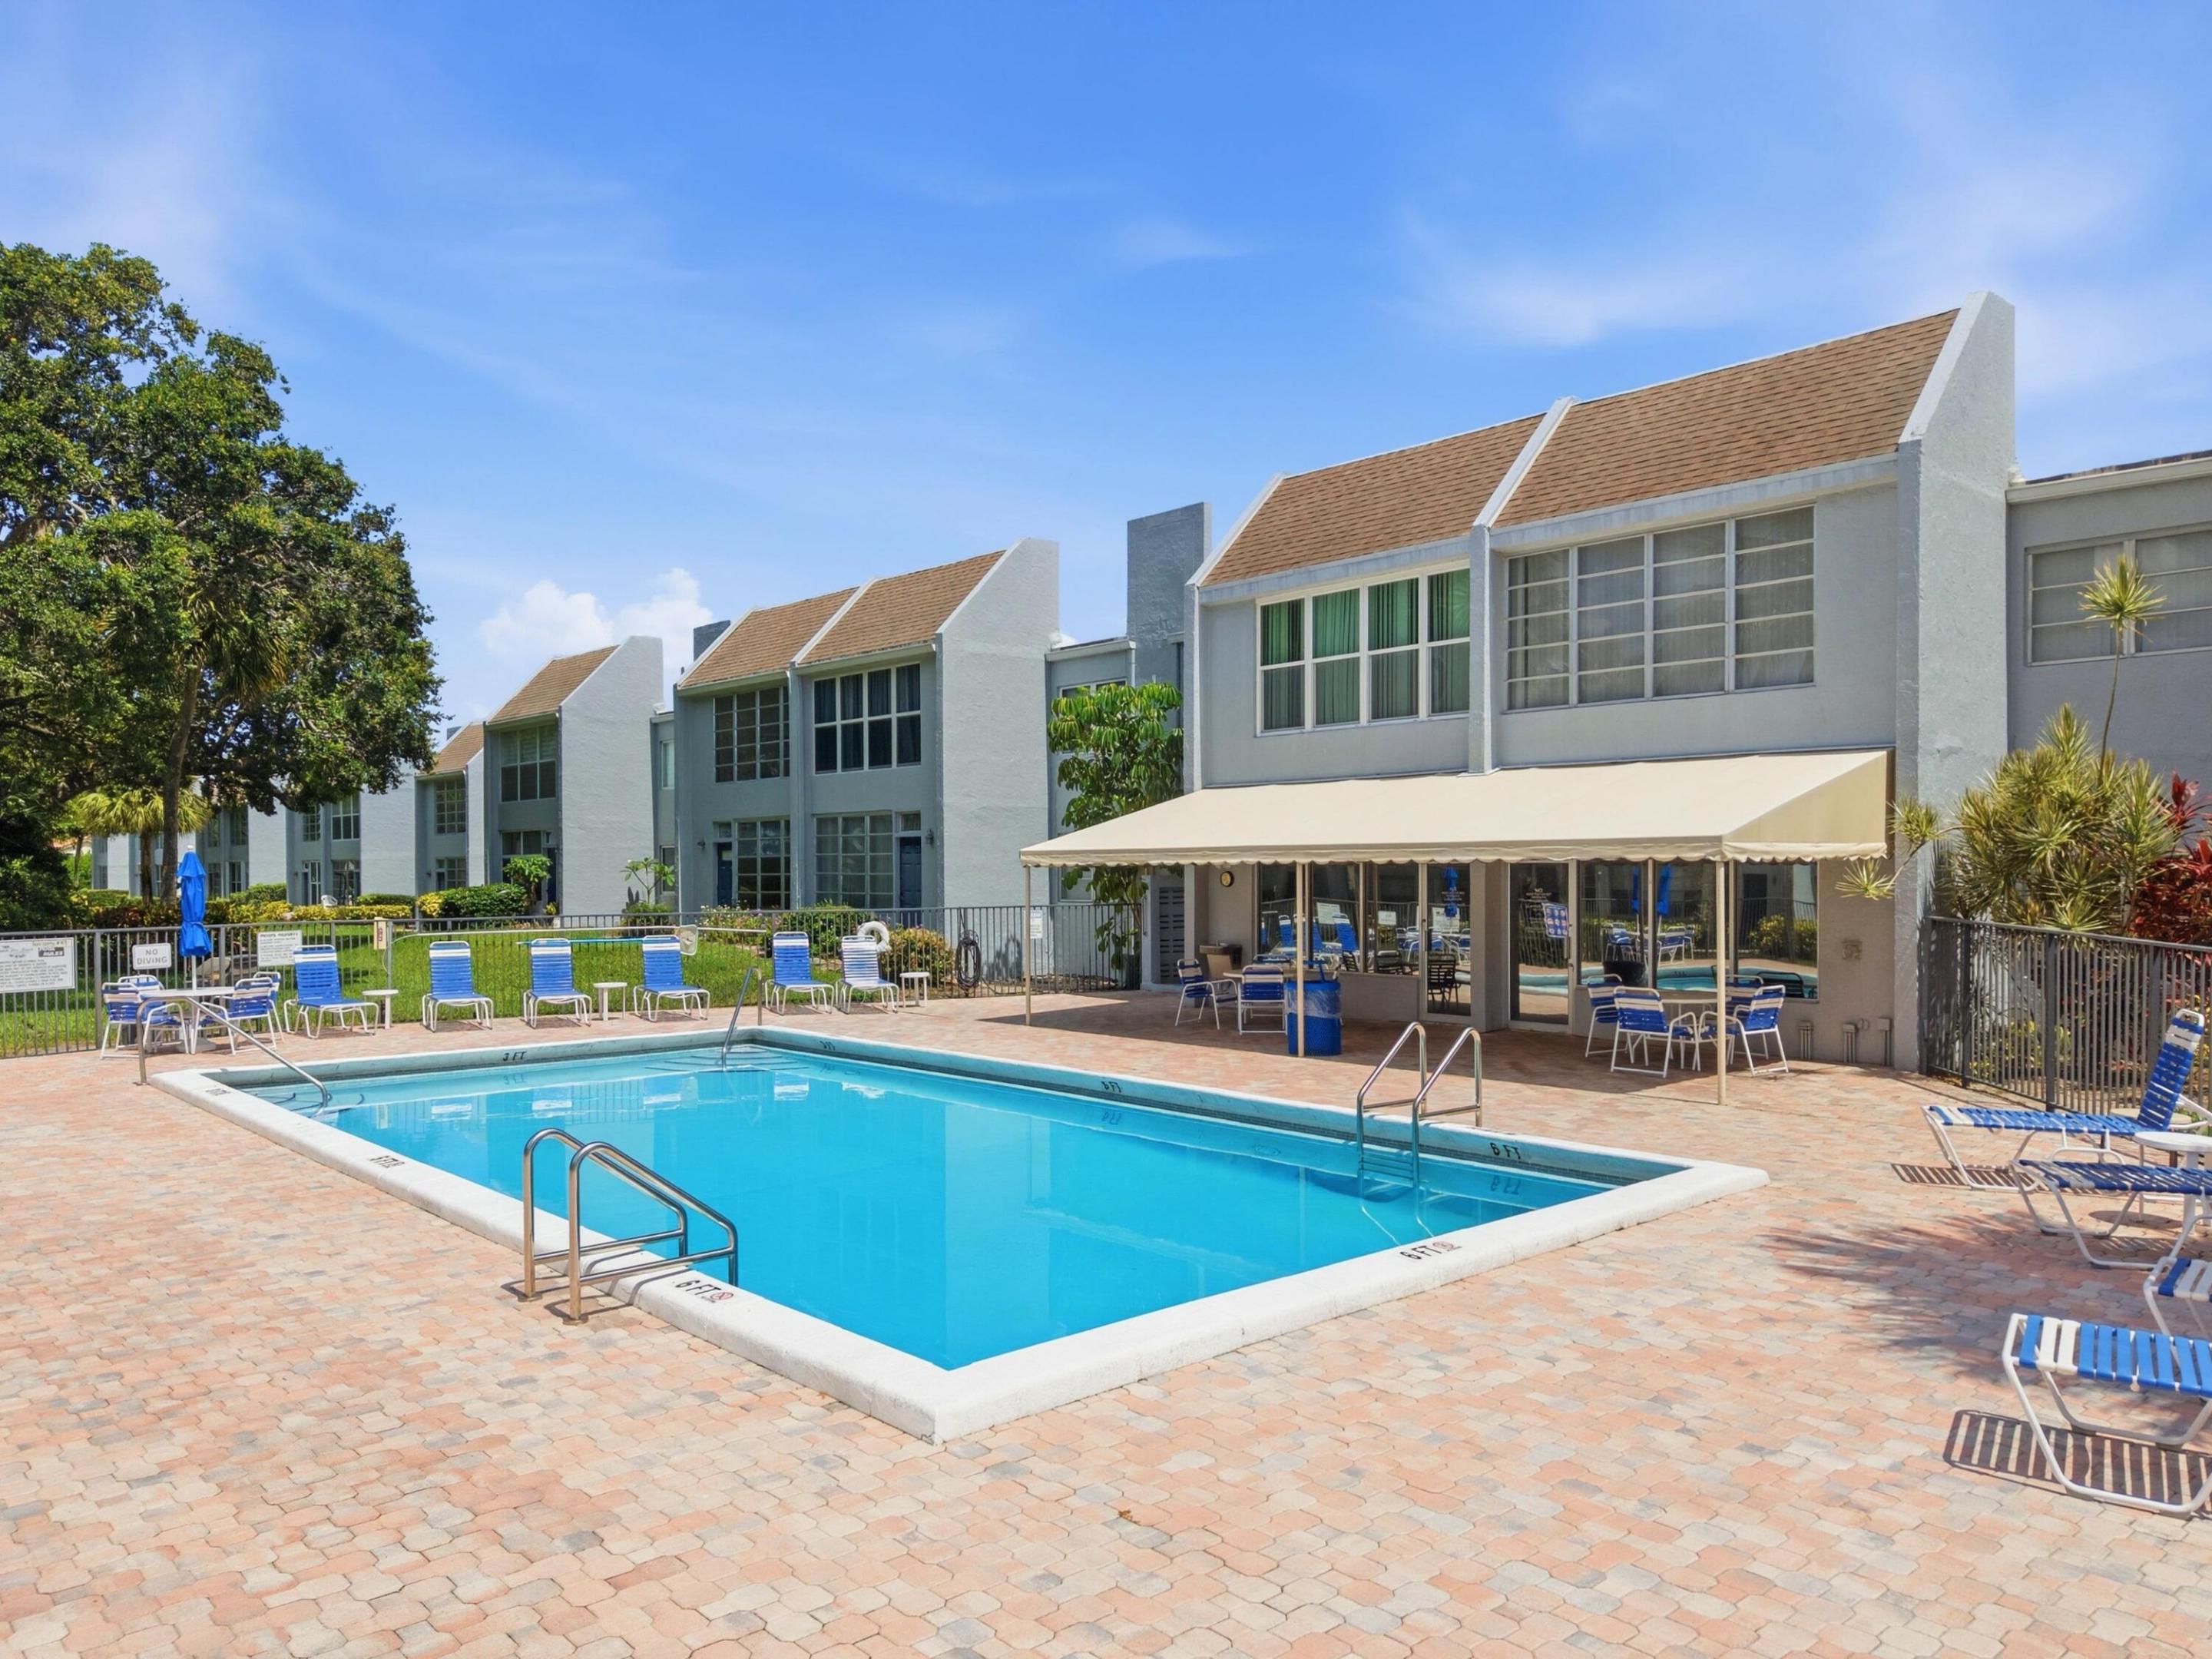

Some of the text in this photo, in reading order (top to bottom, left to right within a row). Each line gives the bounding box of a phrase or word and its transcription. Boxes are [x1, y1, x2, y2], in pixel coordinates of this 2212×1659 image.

[145, 948, 158, 956] NO
[137, 955, 167, 965] DIVING
[512, 1051, 527, 1061] FT
[1503, 1144, 1521, 1160] FT
[1399, 1245, 1442, 1260] 6 FT
[674, 1280, 722, 1296] 6 FT
